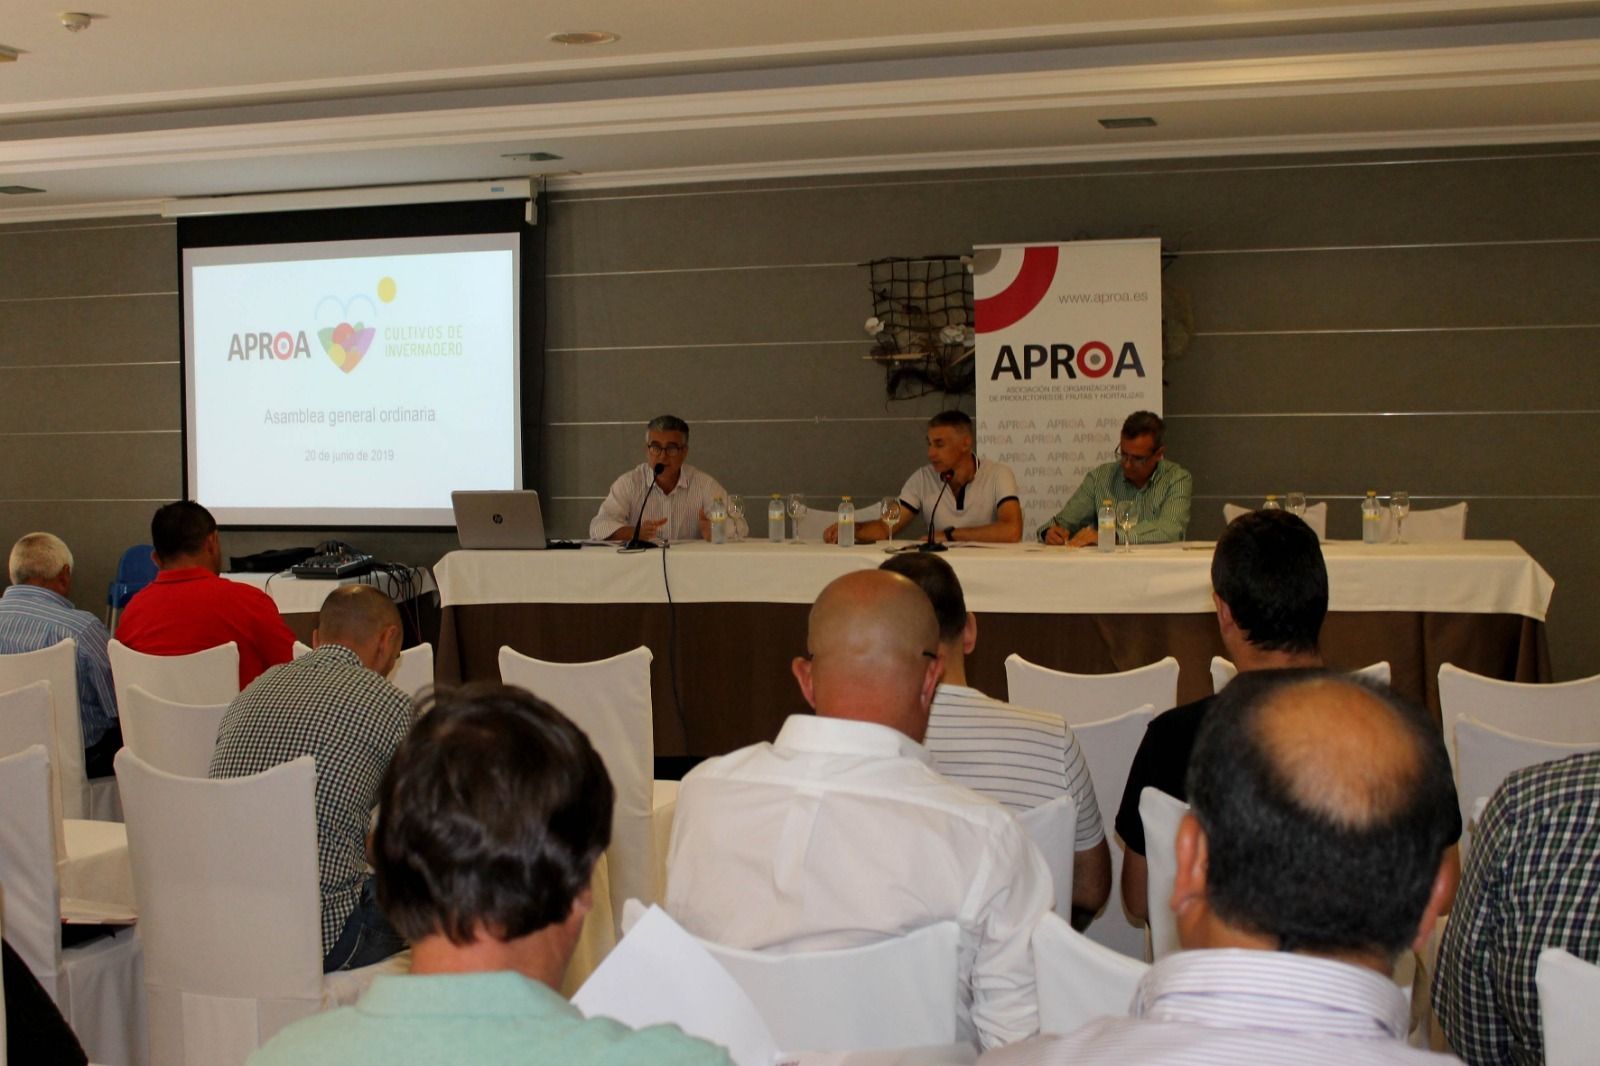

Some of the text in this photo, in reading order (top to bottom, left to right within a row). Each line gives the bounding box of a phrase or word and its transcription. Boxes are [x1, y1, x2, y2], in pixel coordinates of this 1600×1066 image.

[1058, 291, 1148, 304] www.aproa.es
[384, 325, 463, 341] CULTIVOS DE
[227, 330, 311, 361] APROA
[384, 342, 463, 358] INVERNADERO
[990, 341, 1146, 380] APROA
[1051, 384, 1061, 392] DE
[1063, 383, 1127, 392] ORGANIZACIONES
[1065, 392, 1093, 401] FRUTAS
[1100, 391, 1145, 400] HORTALIZAS
[263, 406, 436, 427] Asamblea general ordinaria
[304, 449, 394, 464] 20 de junio de 2019
